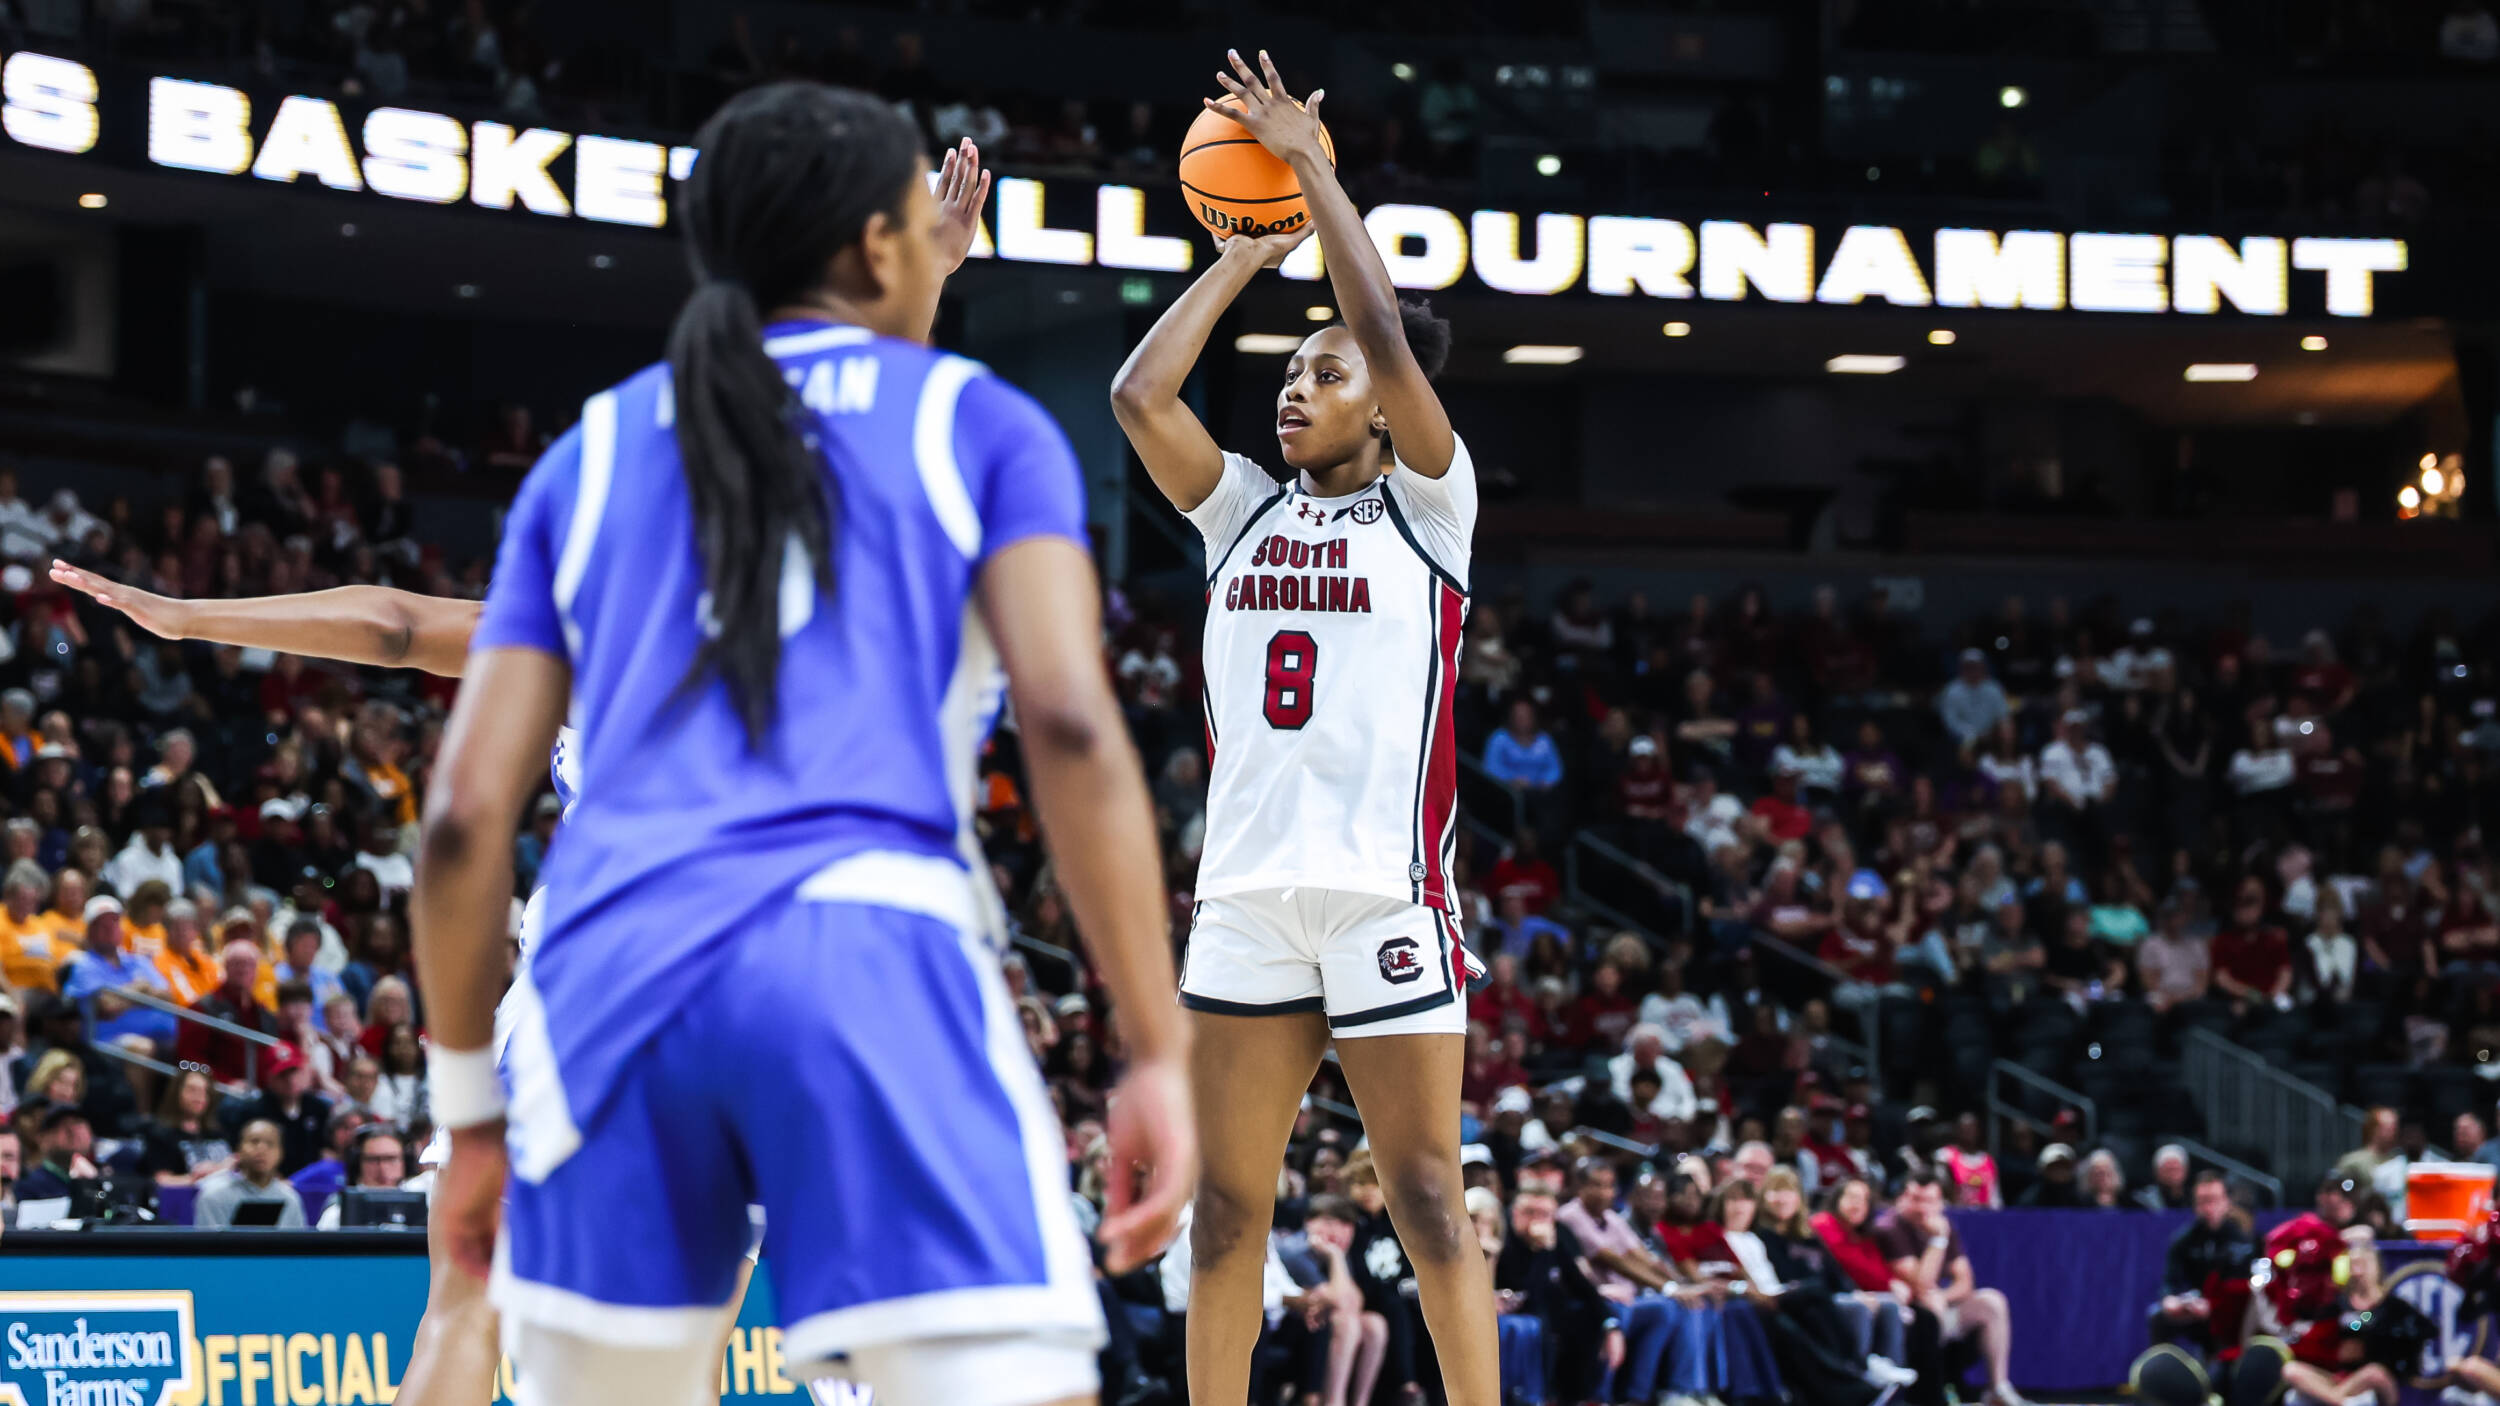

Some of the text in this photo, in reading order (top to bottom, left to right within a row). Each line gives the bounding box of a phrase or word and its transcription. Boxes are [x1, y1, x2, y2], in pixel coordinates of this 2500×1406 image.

[1199, 201, 1305, 234] Wilson
[1352, 499, 1382, 523] SEC
[1251, 534, 1348, 569] SOUTH
[1225, 574, 1372, 613] CAROLINA
[1263, 629, 1318, 730] 8
[7, 1317, 174, 1369] Sanderson
[43, 1370, 150, 1406] Farms
